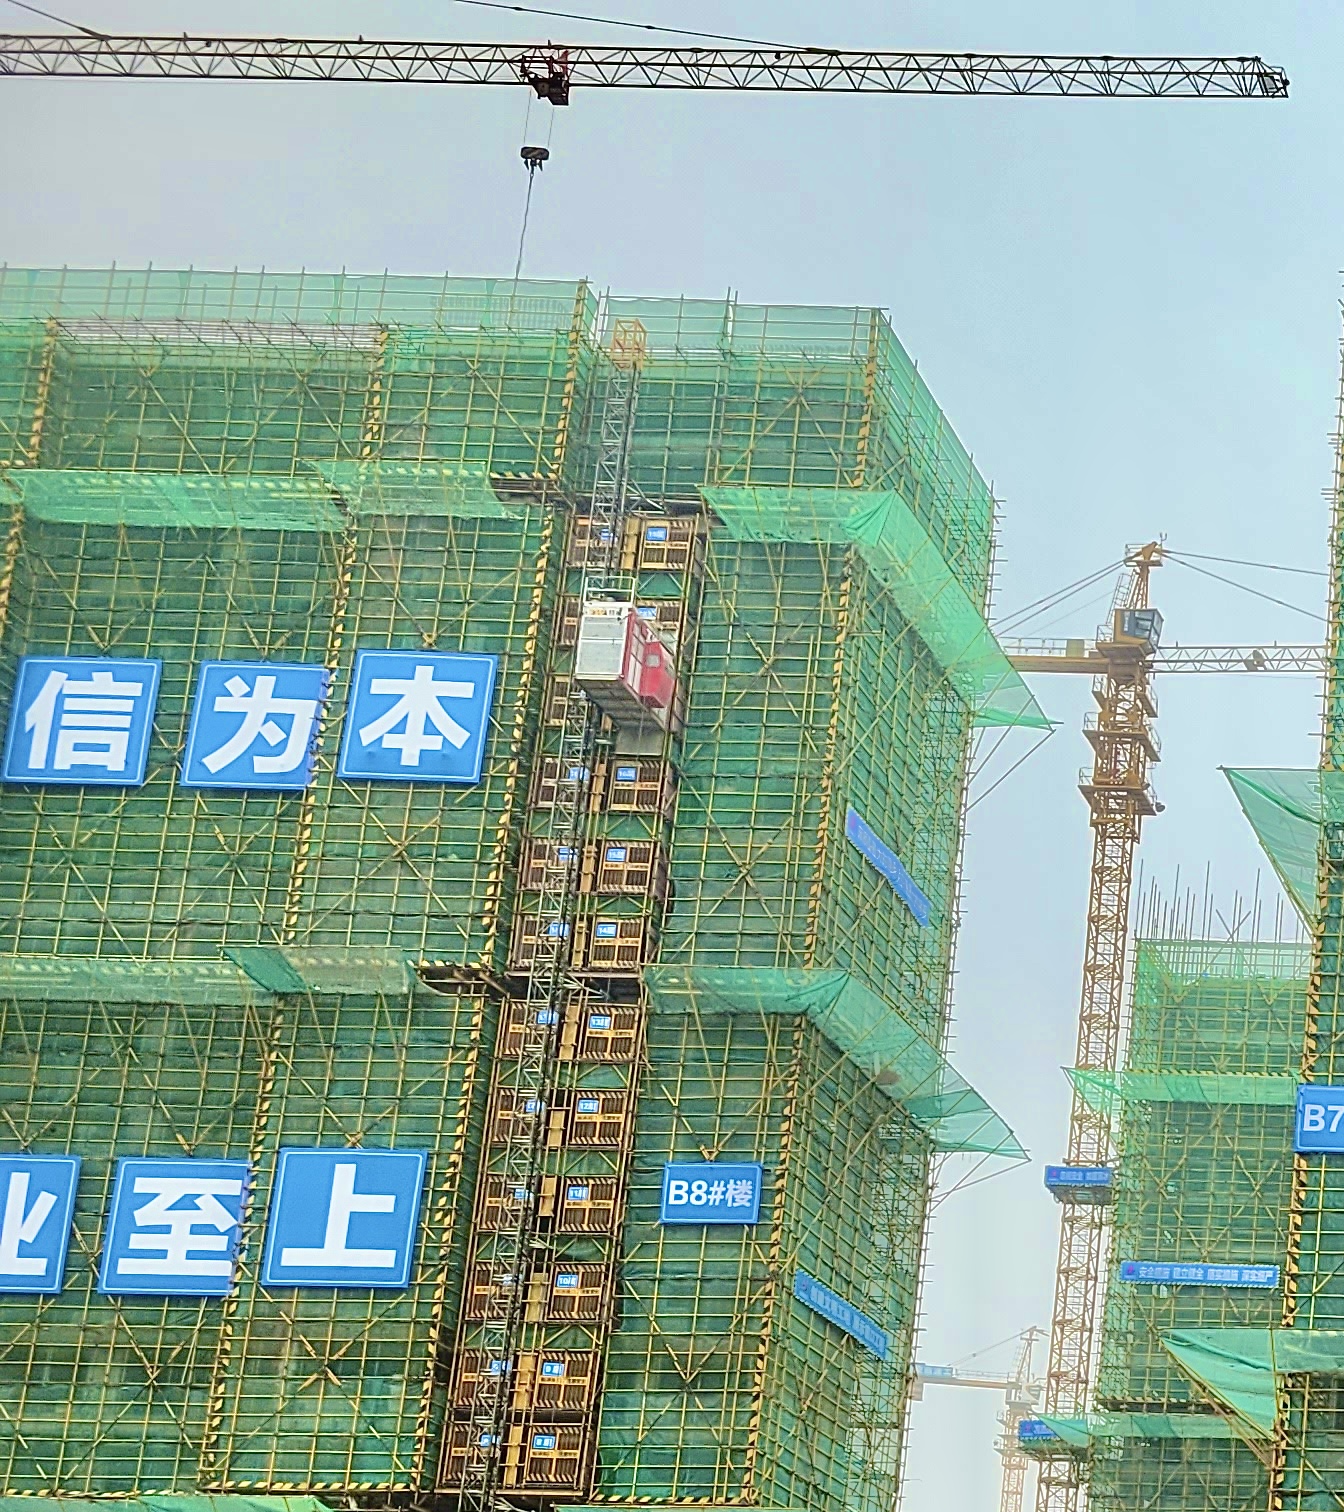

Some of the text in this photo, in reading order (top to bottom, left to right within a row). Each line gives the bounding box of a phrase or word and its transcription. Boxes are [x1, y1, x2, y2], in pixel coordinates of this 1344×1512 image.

[24, 663, 473, 775] 信为本
[667, 1177, 752, 1210] B8#楼
